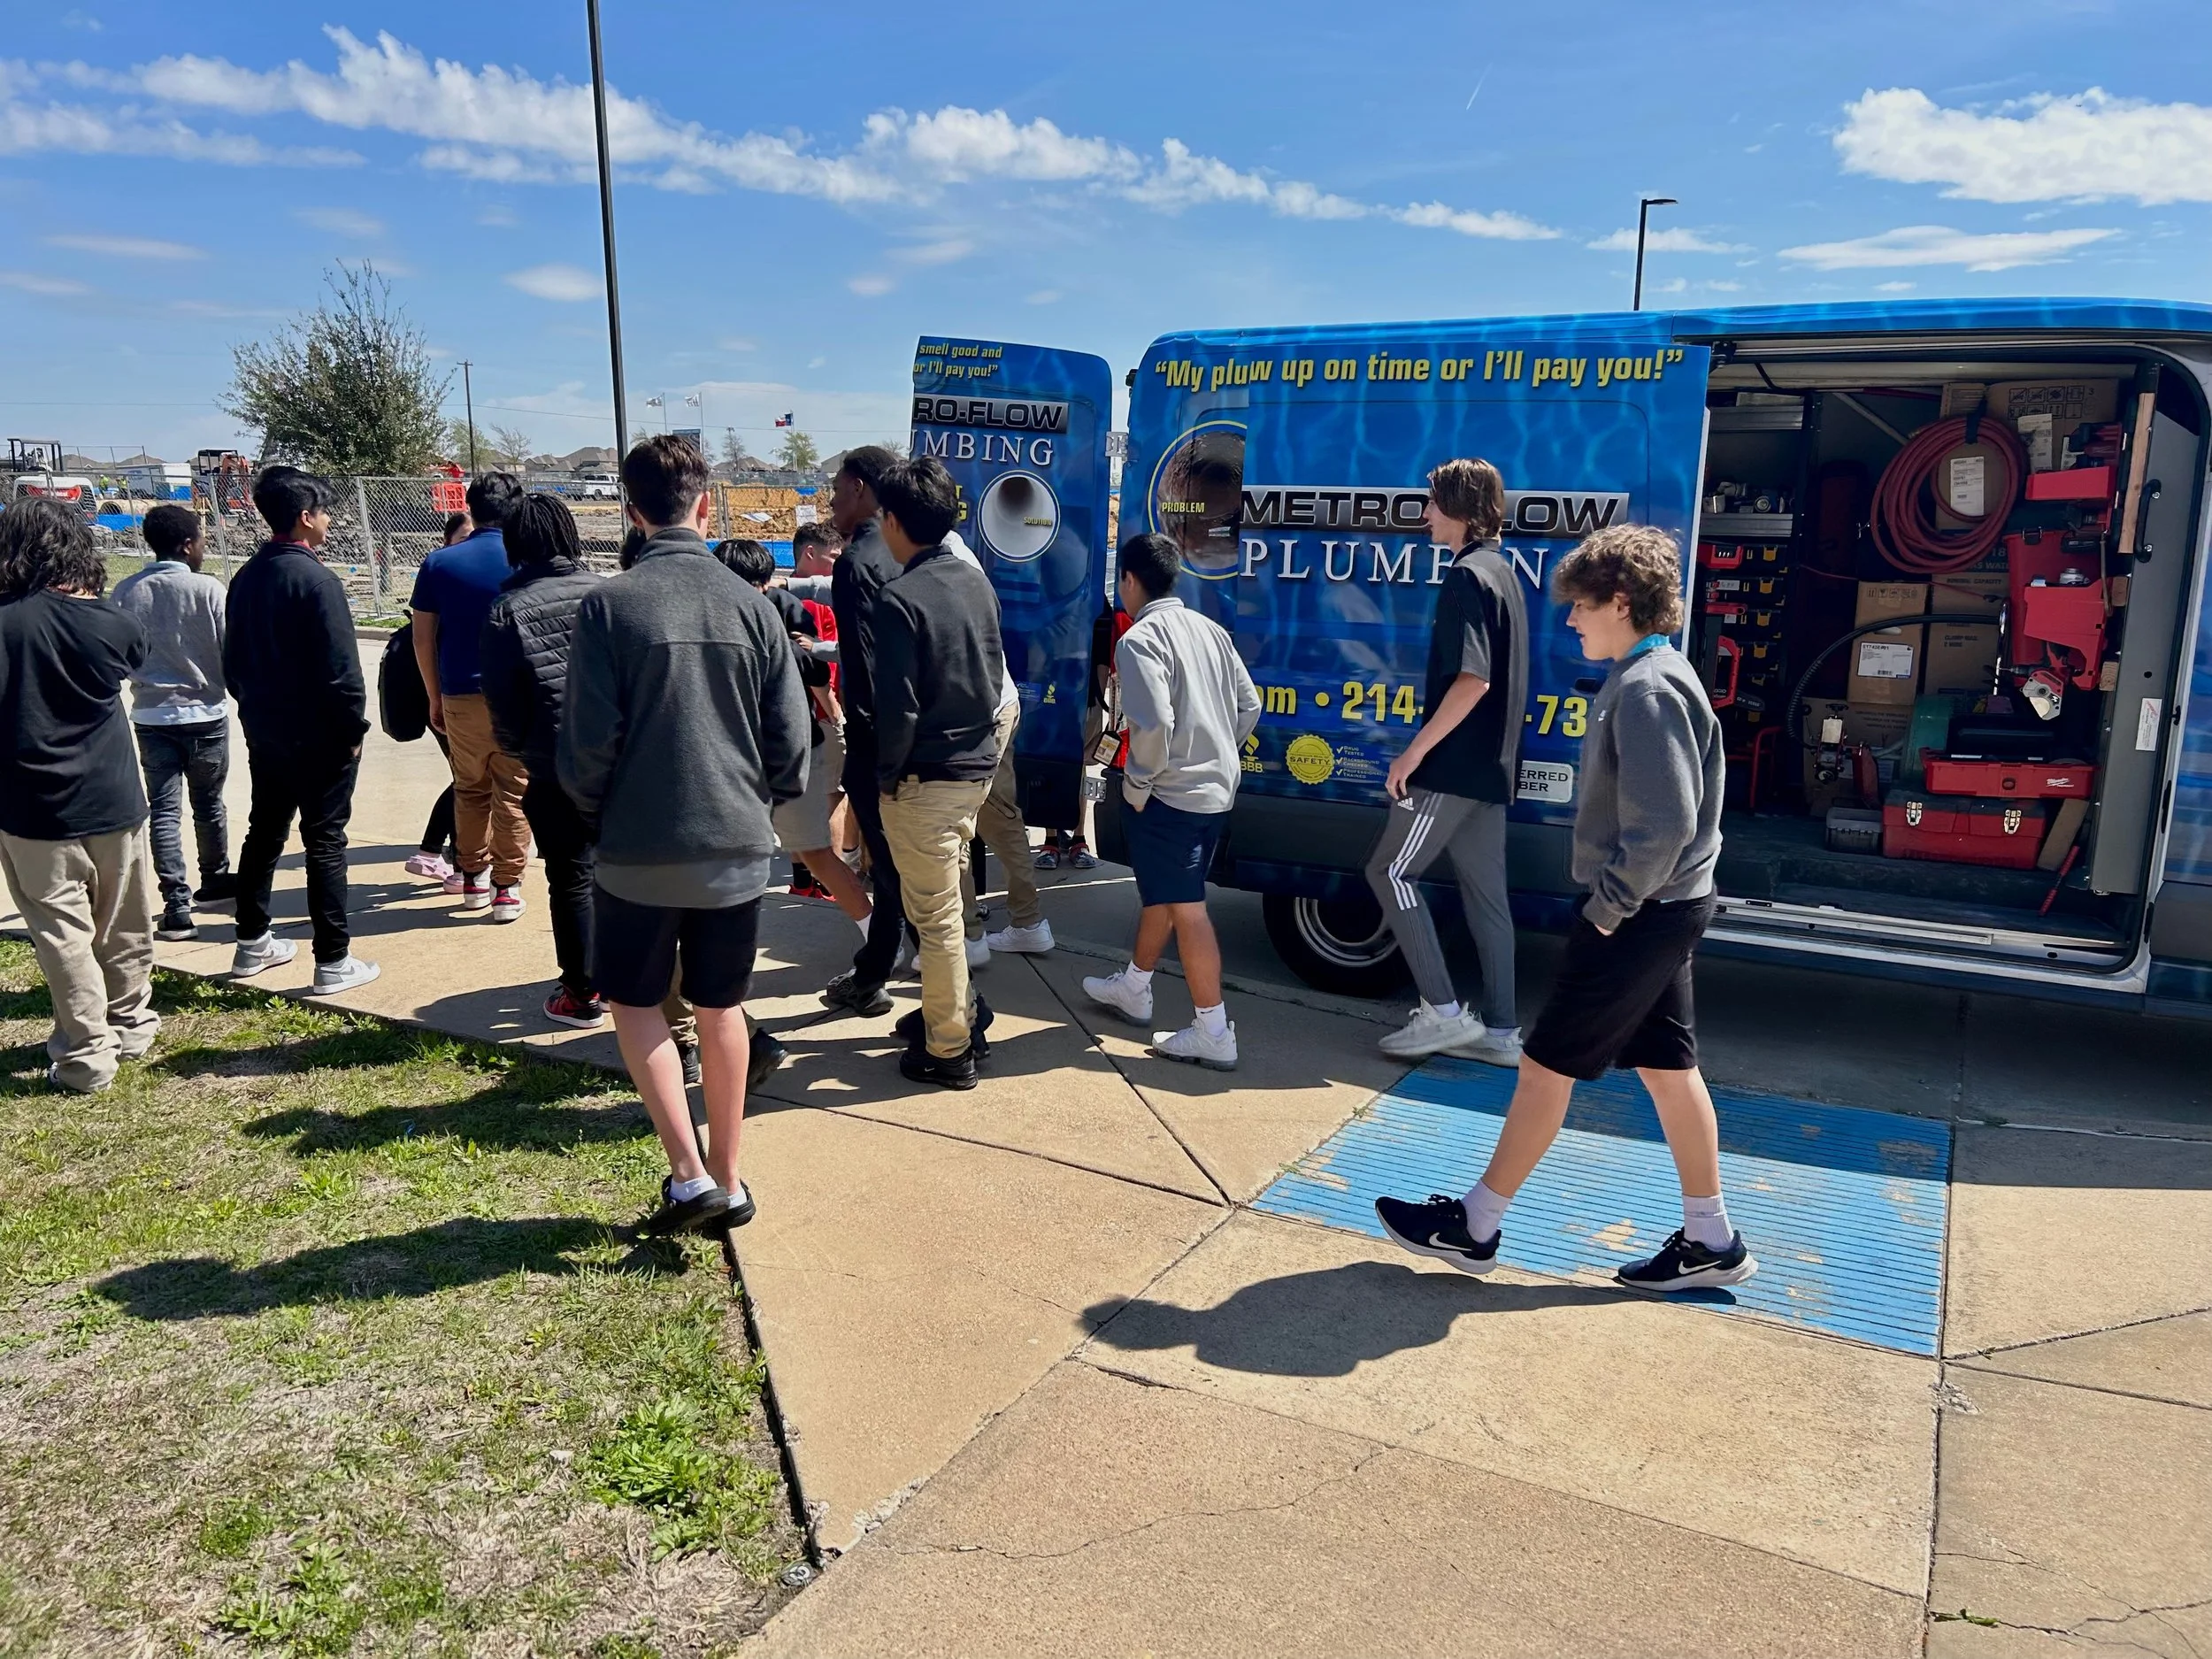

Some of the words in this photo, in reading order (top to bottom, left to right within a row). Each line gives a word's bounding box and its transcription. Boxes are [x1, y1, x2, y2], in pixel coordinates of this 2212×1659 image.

[919, 343, 949, 355] smell
[952, 345, 979, 358] good
[981, 347, 1002, 358] and
[946, 365, 964, 378] pay
[1281, 359, 1315, 388] up
[1324, 358, 1356, 380] on
[1367, 351, 1431, 380] time
[1440, 358, 1474, 380] or
[1532, 357, 1587, 388] pay
[1162, 502, 1205, 513] PROBLEM
[1023, 516, 1052, 526] SOLUTION
[1240, 760, 1263, 773] BBB
[1289, 756, 1330, 767] SAFETY
[1519, 770, 1569, 782] ERRED
[1518, 781, 1548, 793] BER
